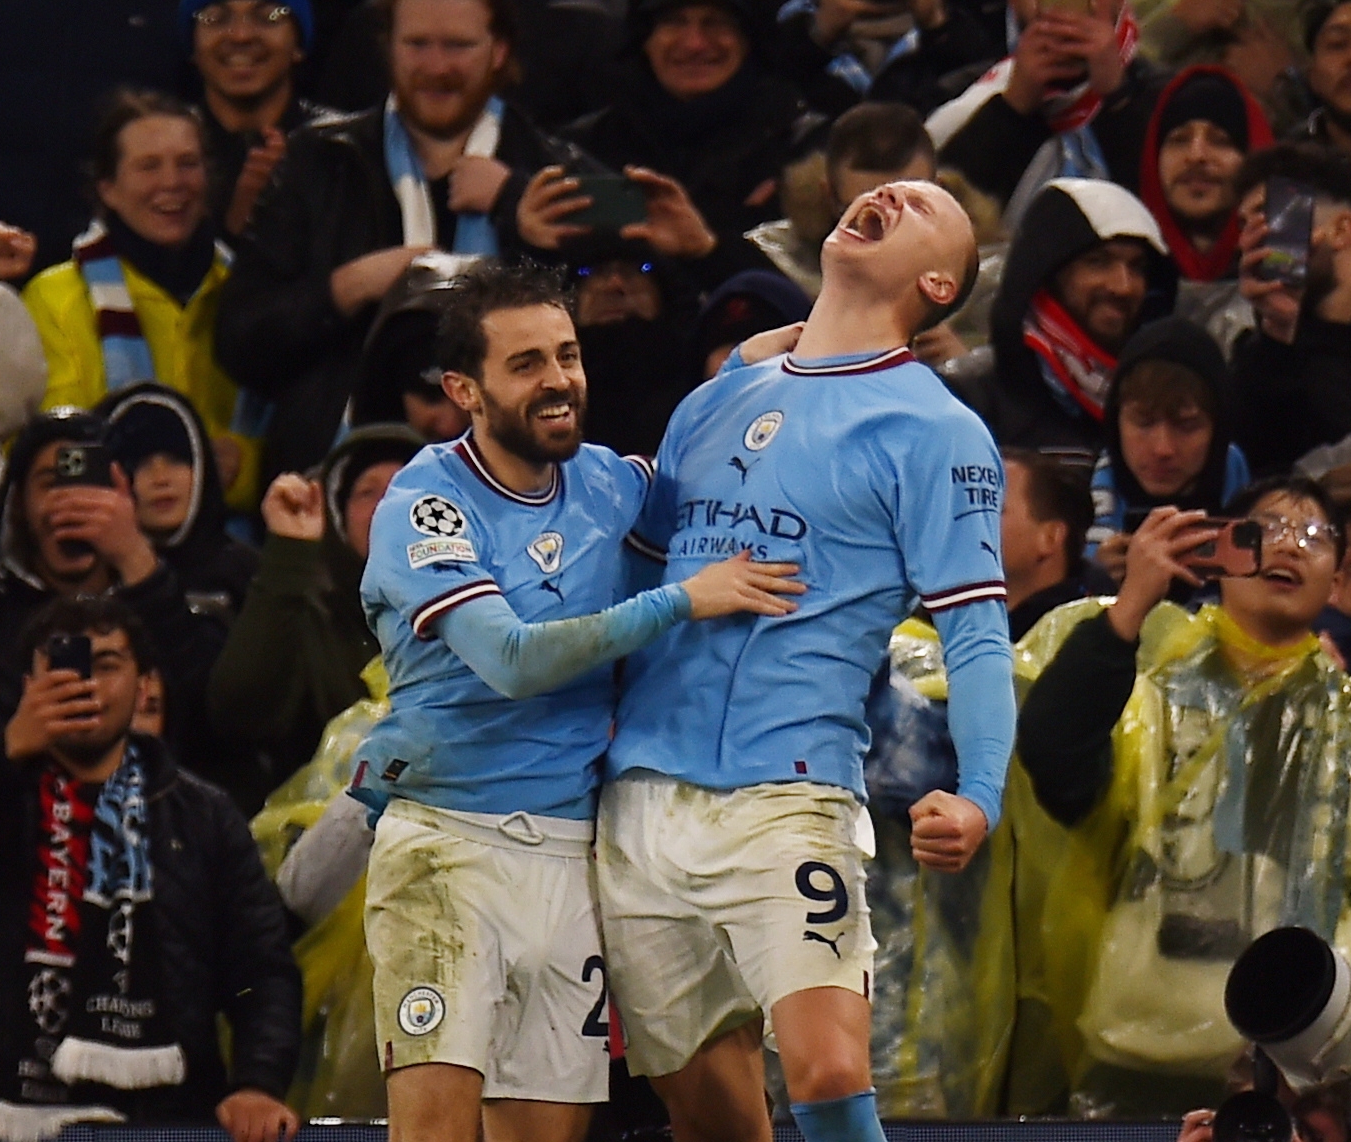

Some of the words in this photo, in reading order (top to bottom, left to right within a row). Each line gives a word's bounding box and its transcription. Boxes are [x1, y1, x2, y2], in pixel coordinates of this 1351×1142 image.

[964, 488, 998, 508] TIRE
[679, 536, 769, 560] AIRWAYS
[45, 801, 74, 941] BAYERN
[795, 861, 848, 924] 9
[582, 955, 609, 1037] 2
